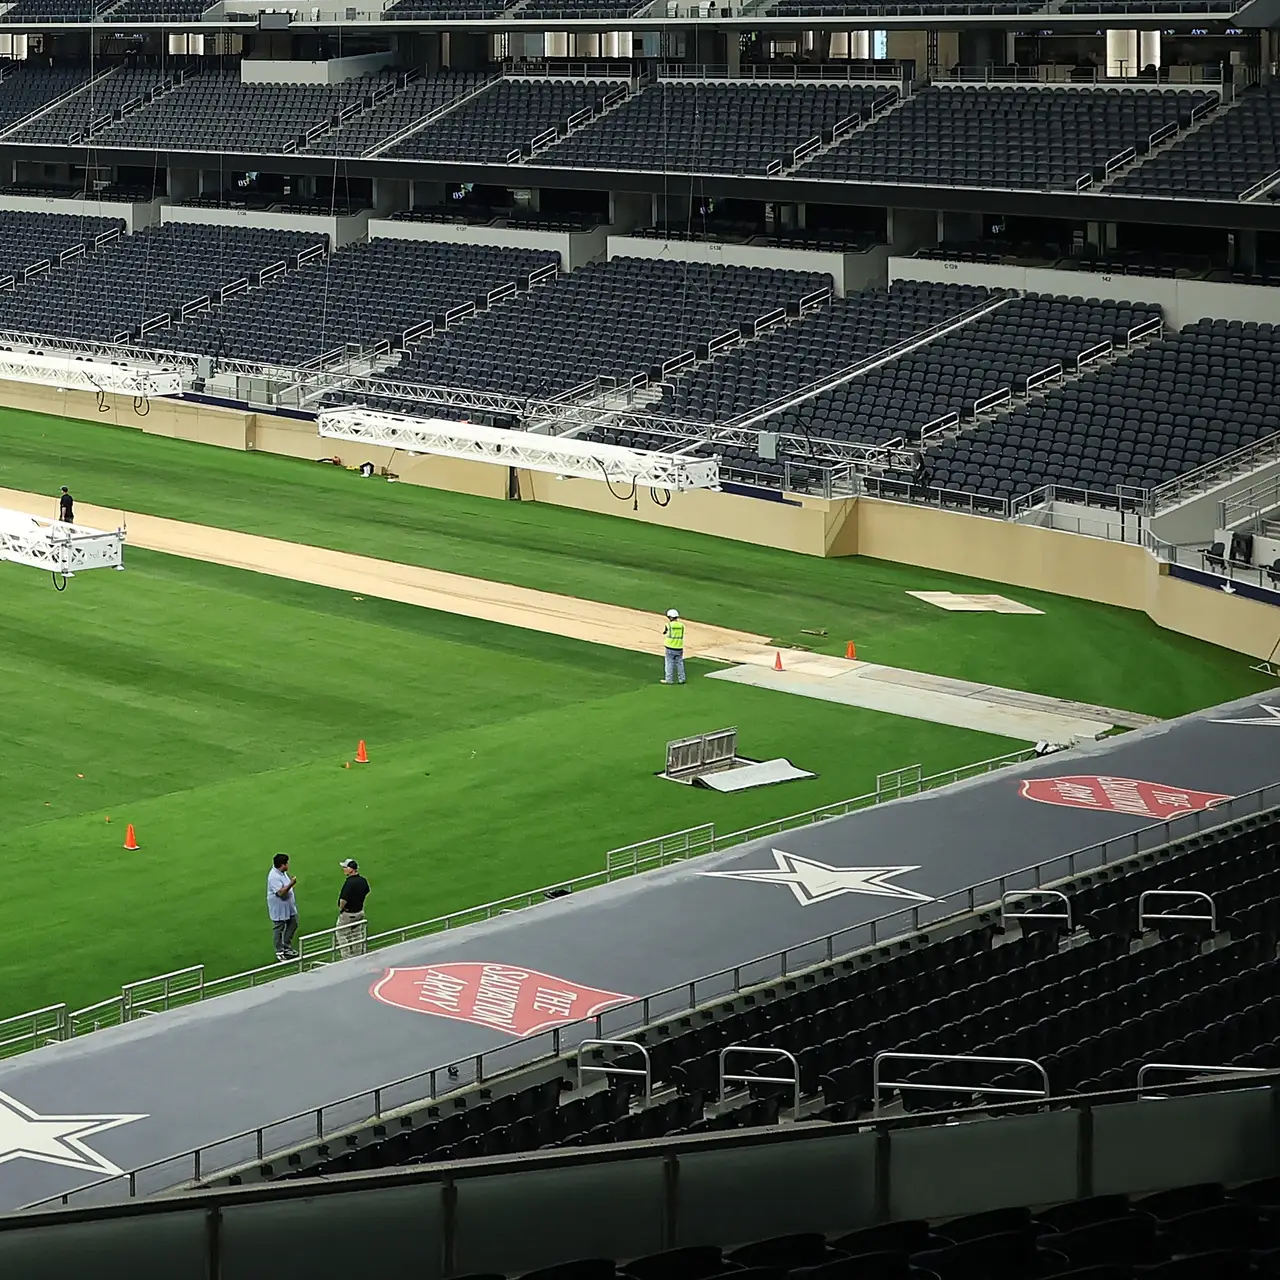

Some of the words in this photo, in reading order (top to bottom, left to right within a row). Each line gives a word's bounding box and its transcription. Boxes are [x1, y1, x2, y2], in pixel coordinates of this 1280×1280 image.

[412, 968, 470, 1013] ARMY
[468, 964, 532, 1030] SALVATION
[531, 984, 578, 1017] THE
